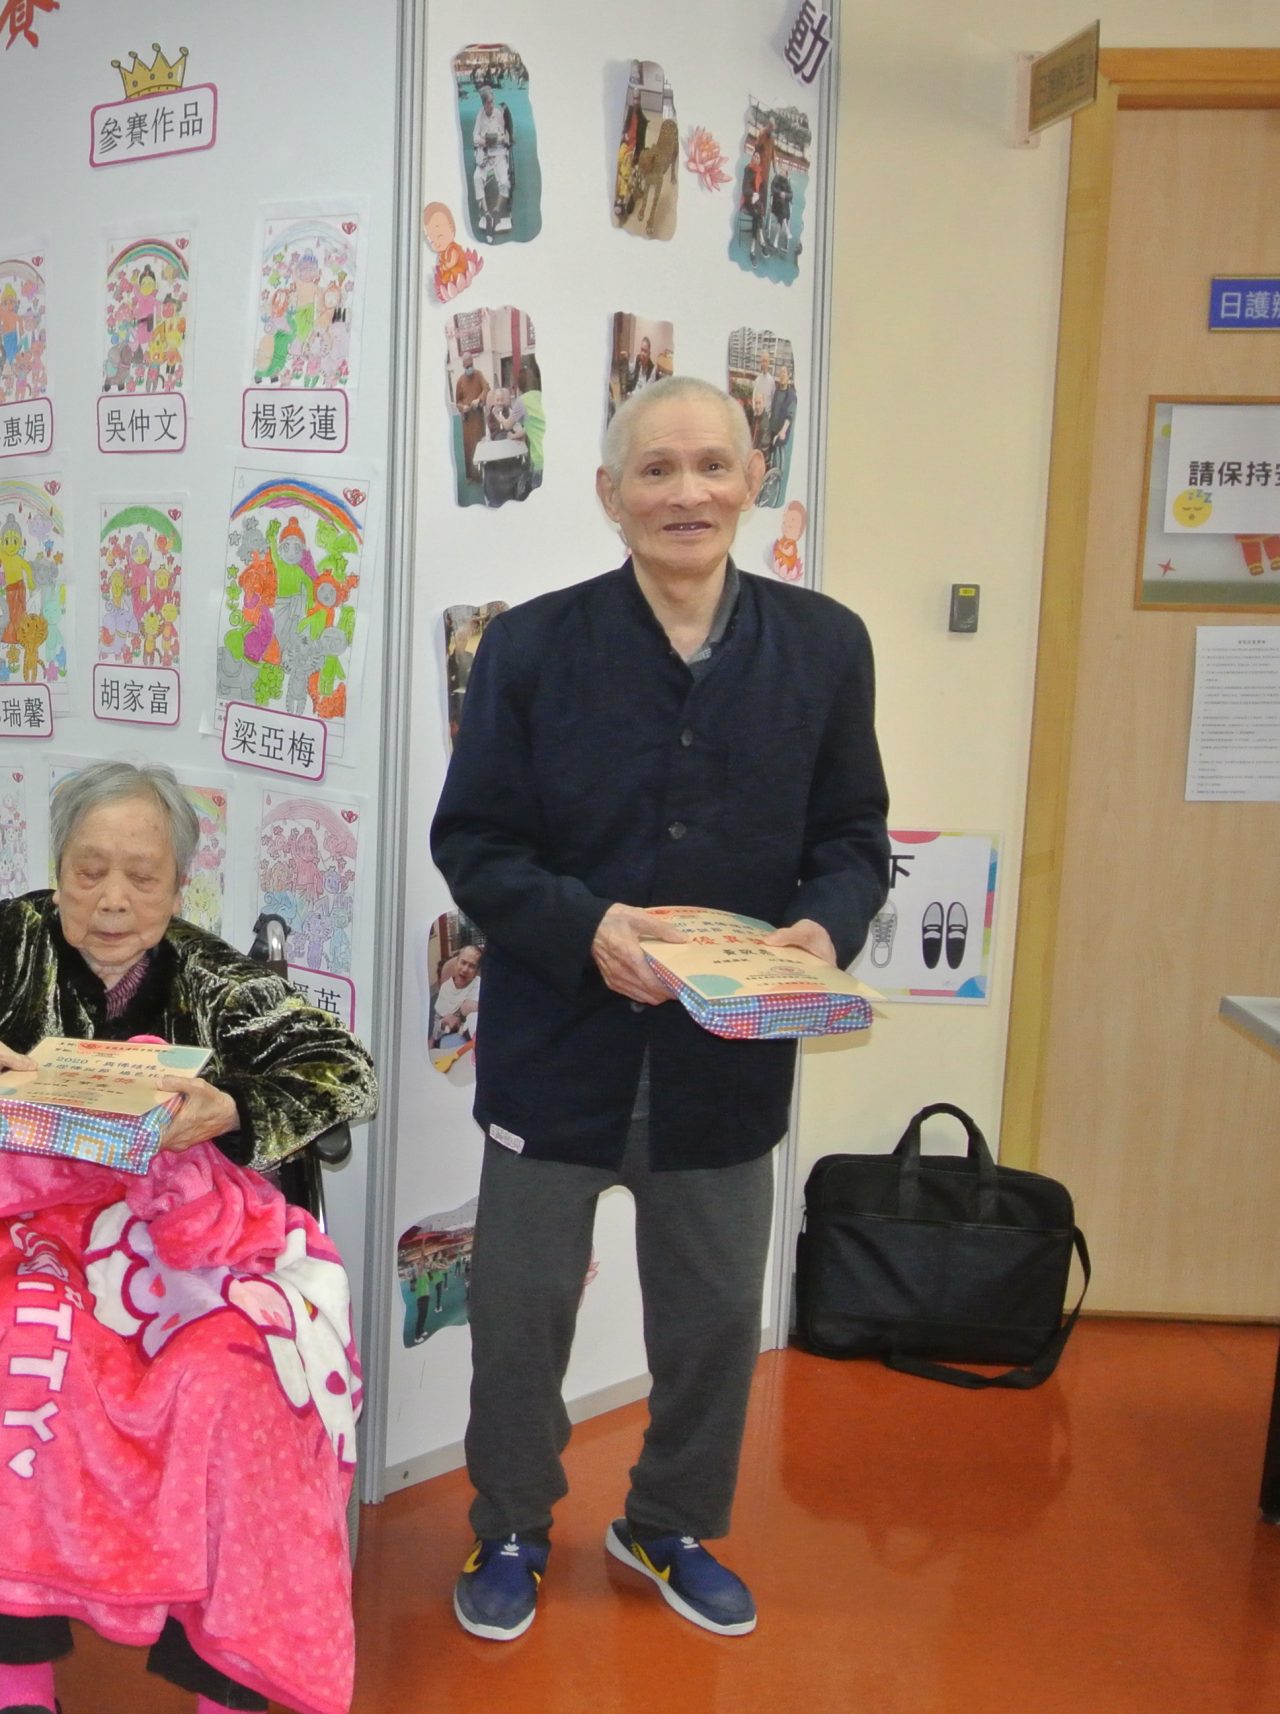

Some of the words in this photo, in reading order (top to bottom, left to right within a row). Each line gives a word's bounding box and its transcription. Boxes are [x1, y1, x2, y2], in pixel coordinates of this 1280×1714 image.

[99, 101, 204, 155] 參賽作品
[105, 407, 178, 443] 吳仲文
[251, 402, 338, 441] 楊彩蓮
[100, 677, 171, 715] 胡家富
[231, 717, 316, 768] 梁亞梅
